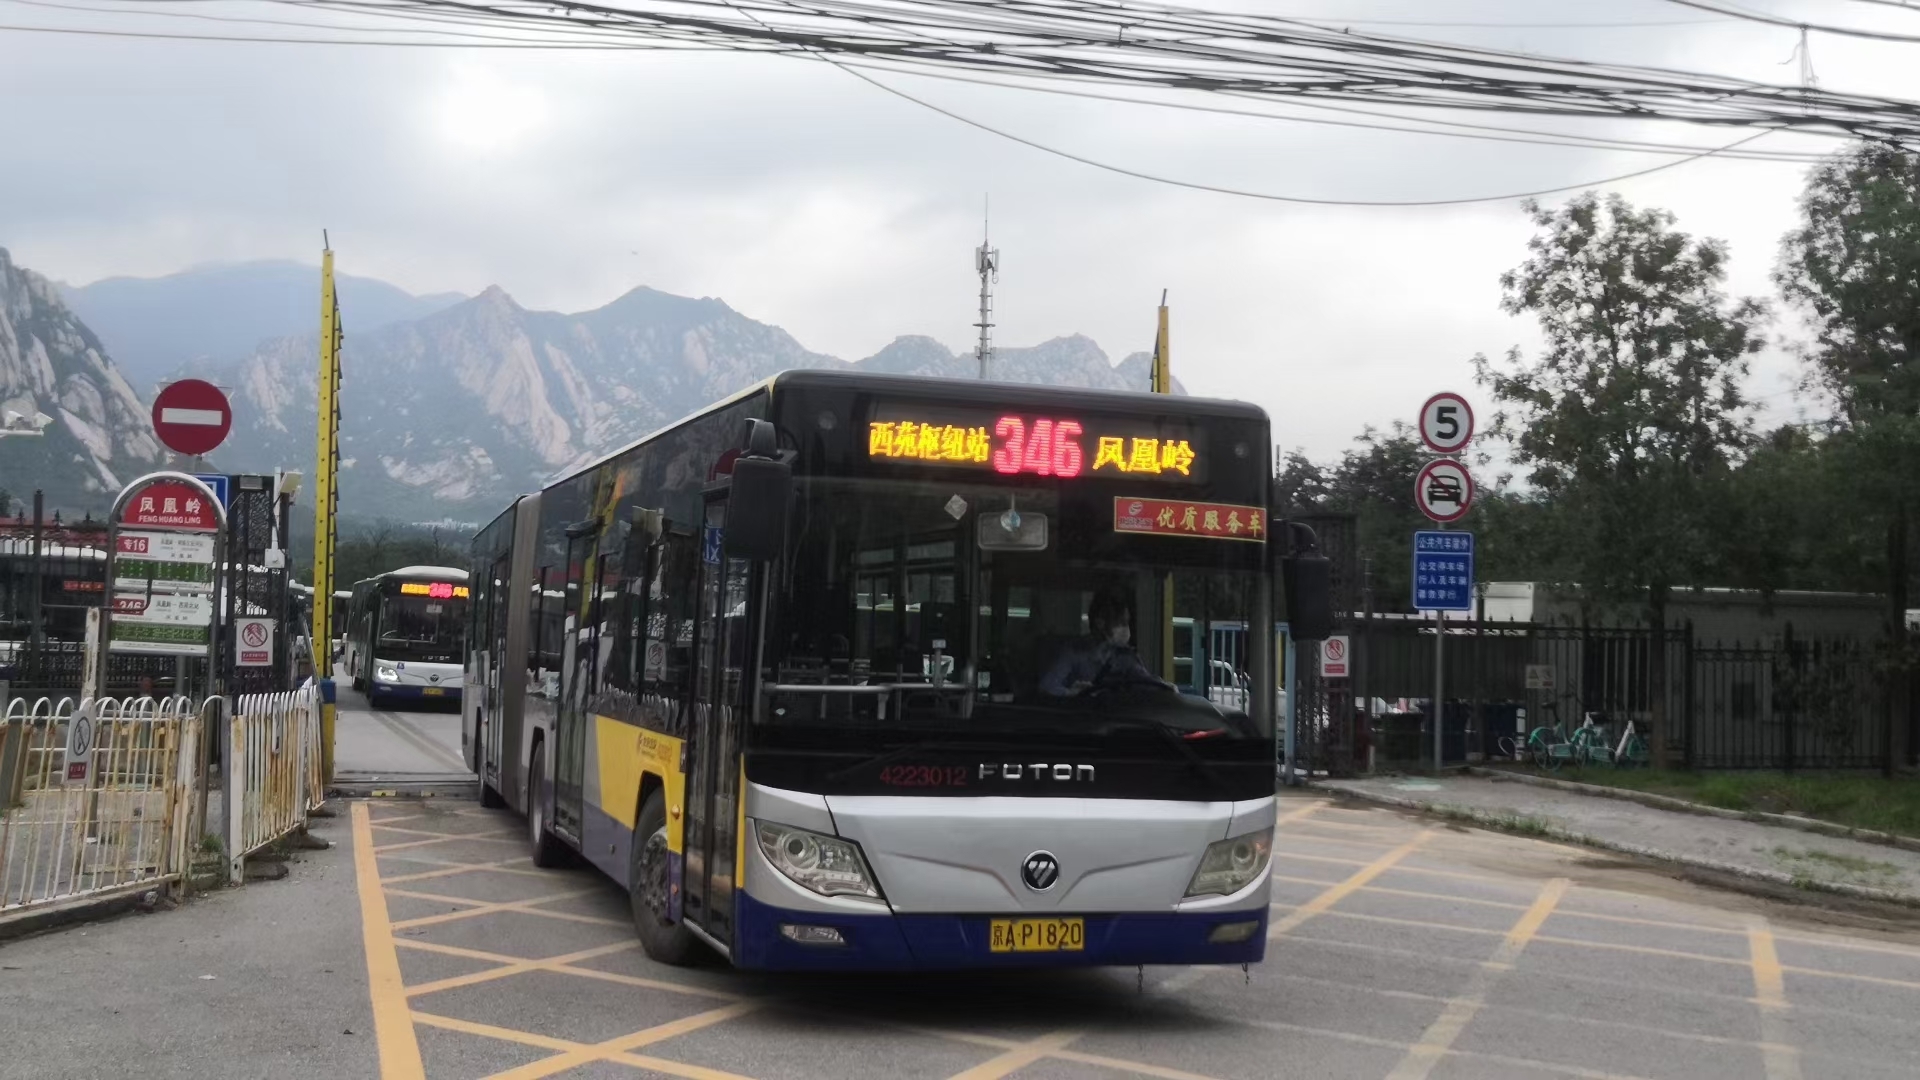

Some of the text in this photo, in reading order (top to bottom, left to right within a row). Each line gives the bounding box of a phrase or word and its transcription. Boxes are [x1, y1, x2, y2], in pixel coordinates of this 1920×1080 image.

[1435, 406, 1458, 440] 5
[869, 417, 1195, 477] 西苑枢纽站 346 凤凰岭
[139, 496, 201, 514] 凤凰岭
[138, 514, 201, 524] FENG HUANG LING
[1156, 506, 1262, 537] 优质服务车
[123, 538, 146, 552] 专16
[880, 766, 967, 786] 4223012
[978, 763, 1095, 782] FOTON
